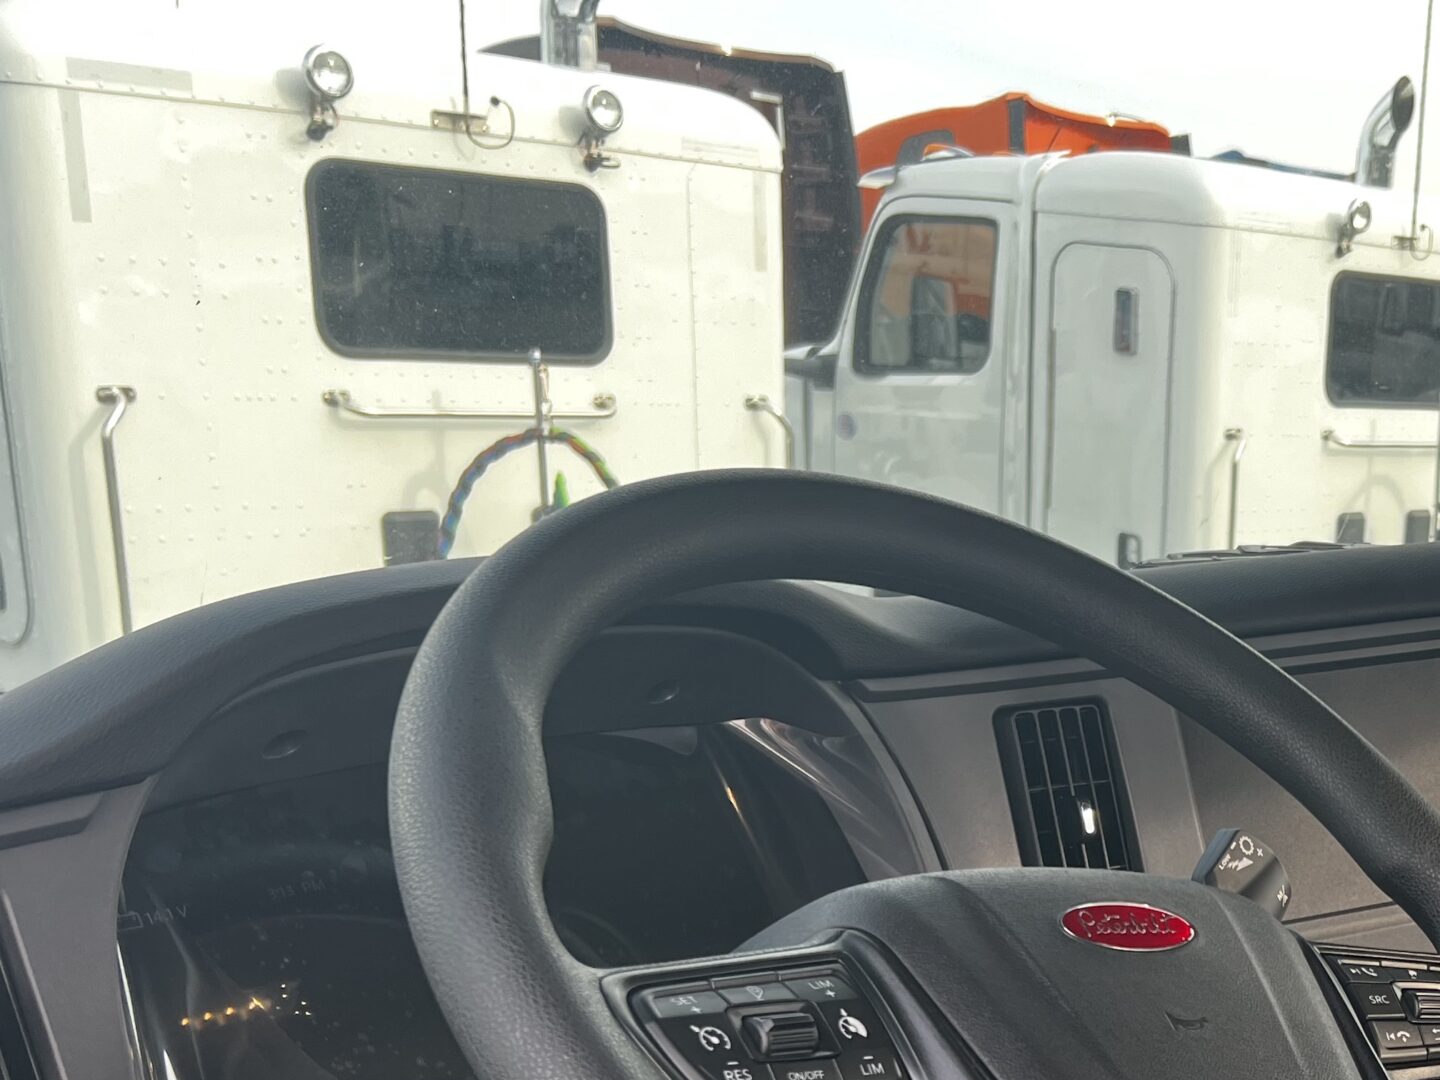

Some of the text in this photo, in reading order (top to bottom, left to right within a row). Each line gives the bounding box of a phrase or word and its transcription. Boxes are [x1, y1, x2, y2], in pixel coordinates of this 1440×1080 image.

[1078, 909, 1177, 938] Peterbilt
[808, 979, 835, 990] LIM
[671, 996, 699, 1006] SET
[1368, 995, 1391, 1005] SRC
[860, 1063, 885, 1077] LIM
